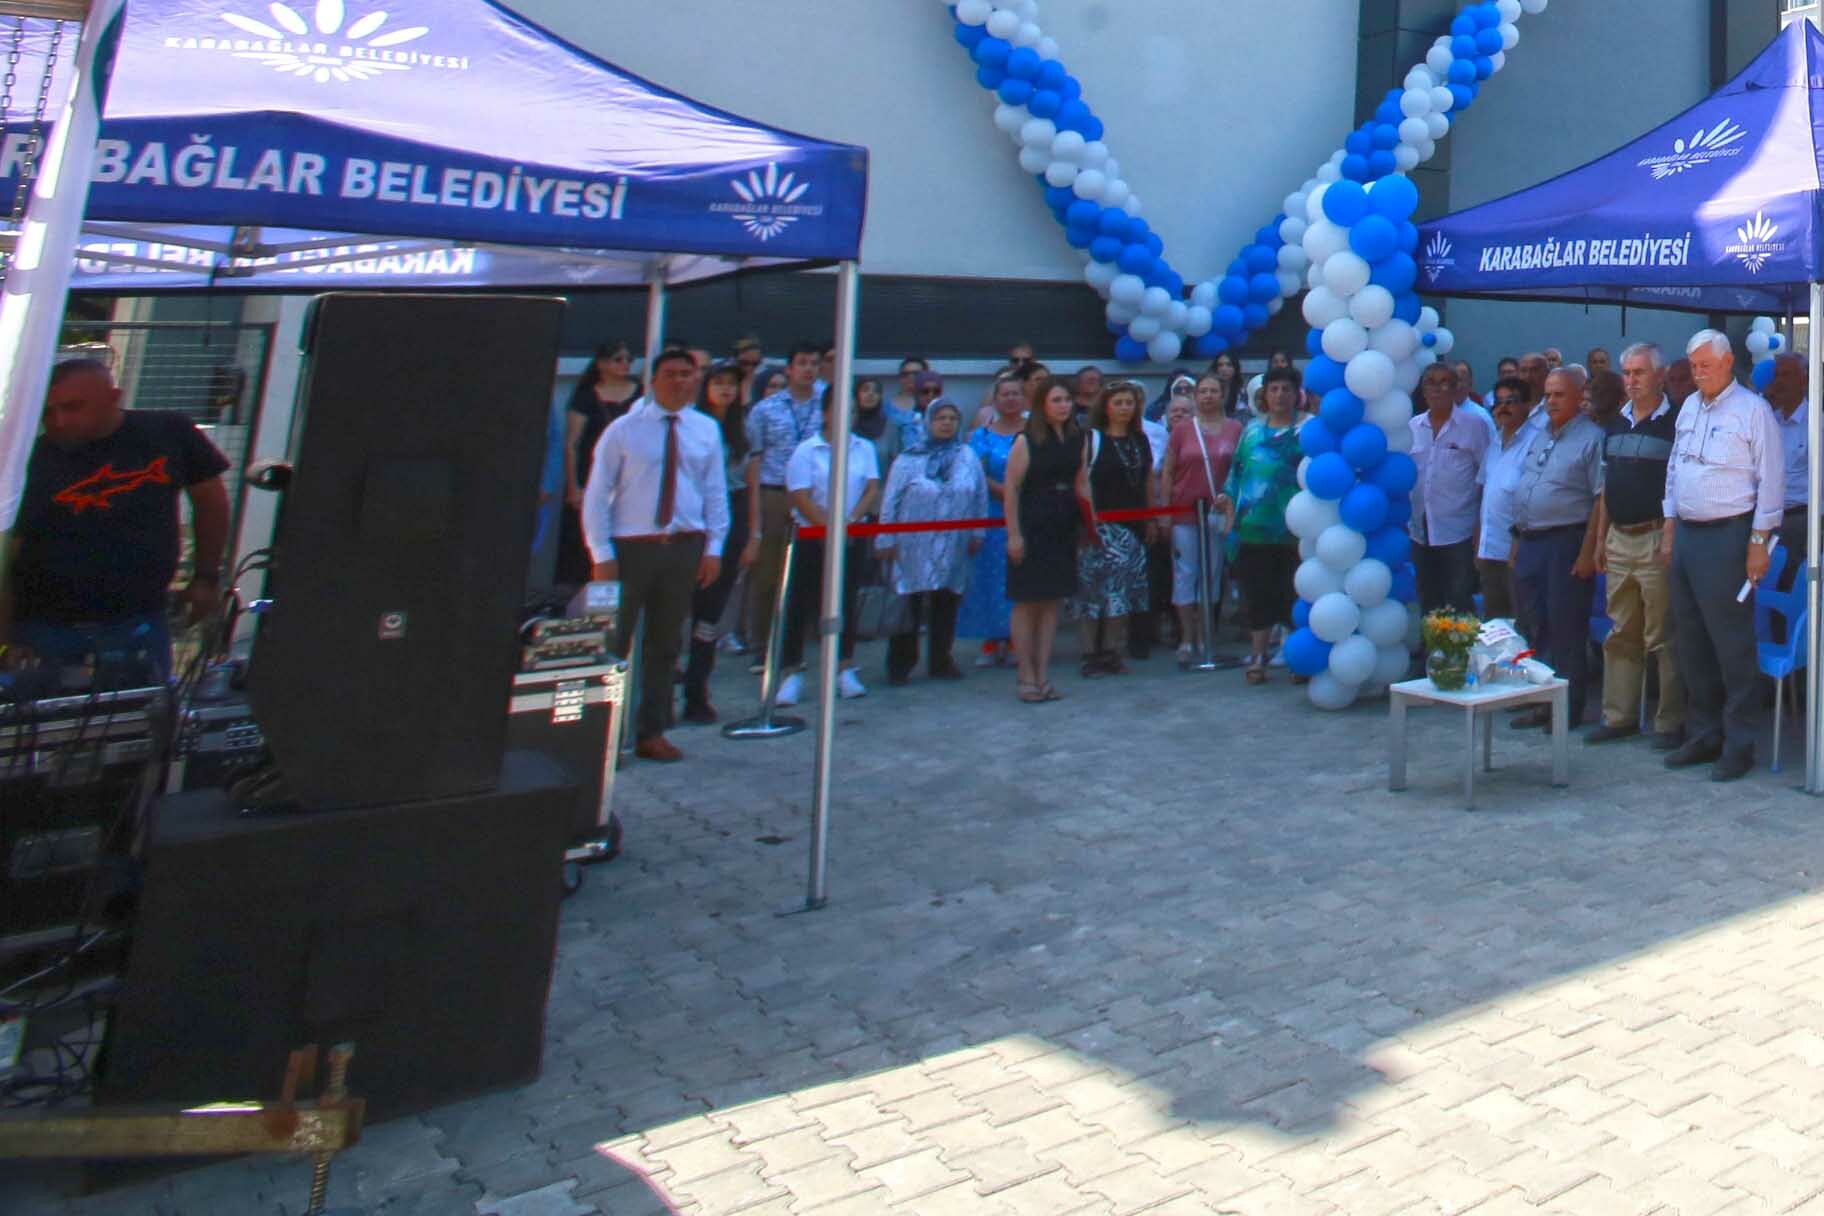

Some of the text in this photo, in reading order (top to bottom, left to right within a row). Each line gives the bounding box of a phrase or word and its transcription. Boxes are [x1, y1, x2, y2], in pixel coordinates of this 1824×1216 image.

[339, 46, 470, 71] BELEDİYESİ
[0, 132, 630, 220] RBAĞLAR BELEDİYESİ
[1479, 232, 1691, 273] KARABAĞLAR BELEDİYESİ
